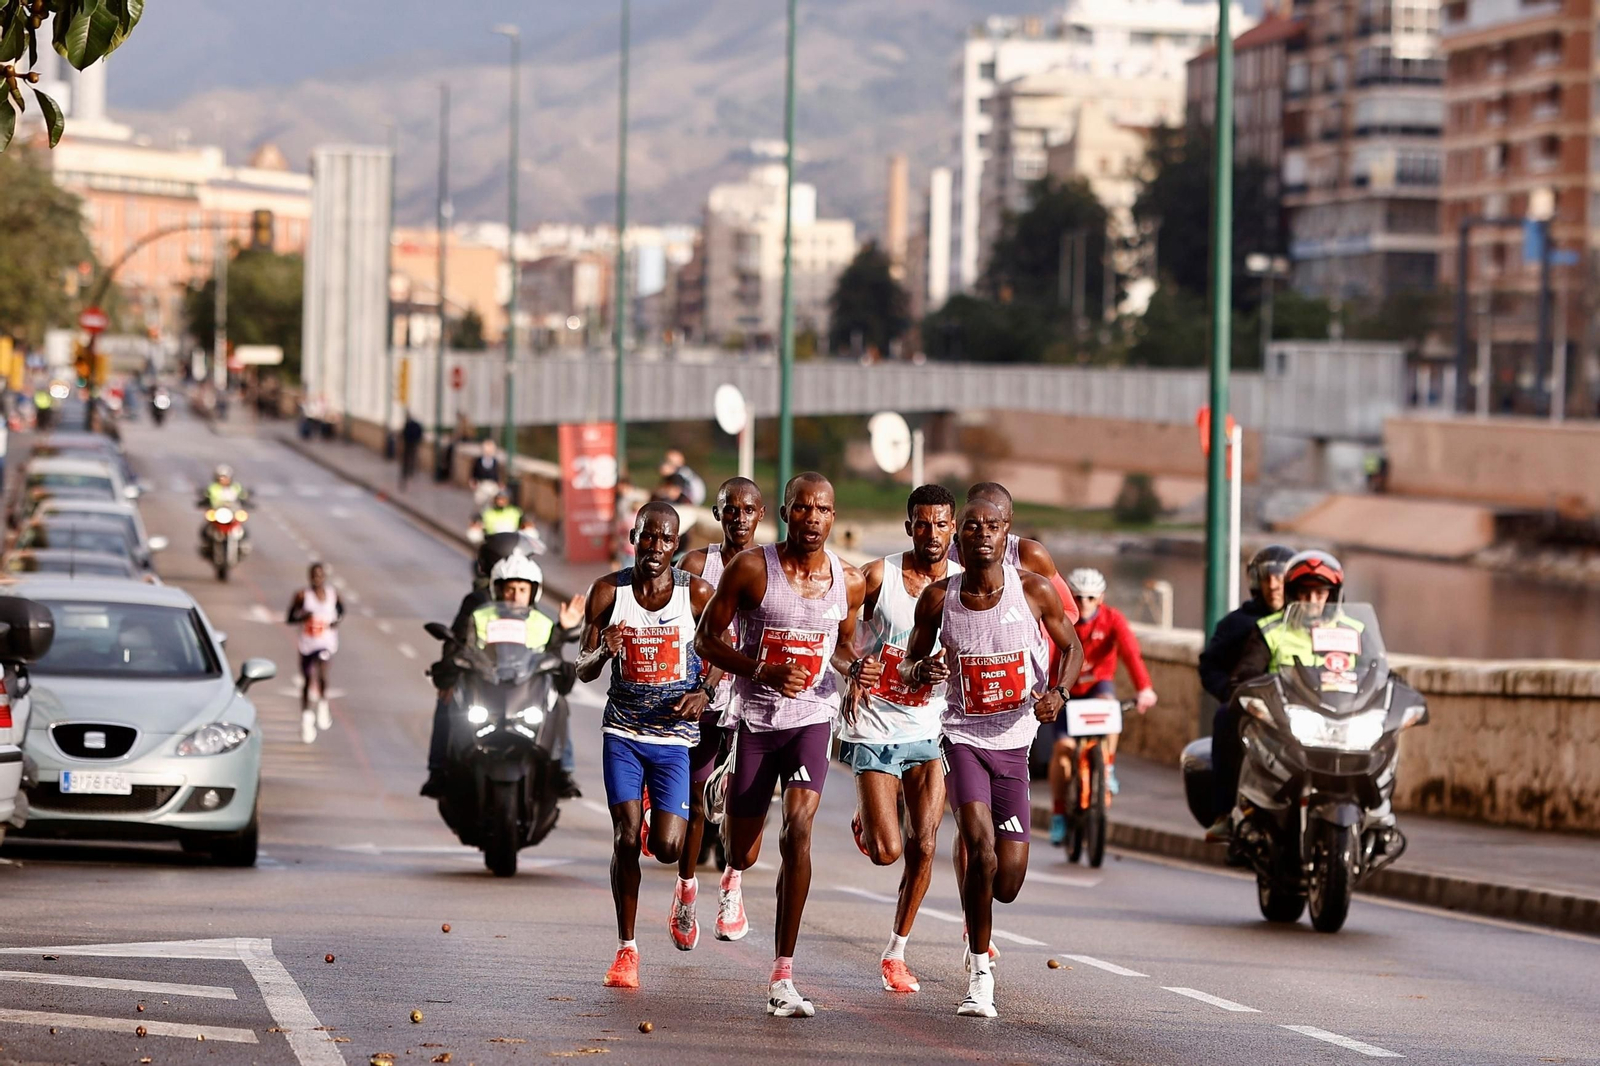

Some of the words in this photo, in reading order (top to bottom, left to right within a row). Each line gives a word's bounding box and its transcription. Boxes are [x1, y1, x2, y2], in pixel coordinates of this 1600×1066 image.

[634, 627, 675, 636] GENERALI
[781, 633, 821, 642] GENERALI
[640, 646, 658, 654] DICH
[977, 653, 1020, 665] GENERALI
[981, 670, 1006, 679] PACER
[988, 682, 1000, 690] 22
